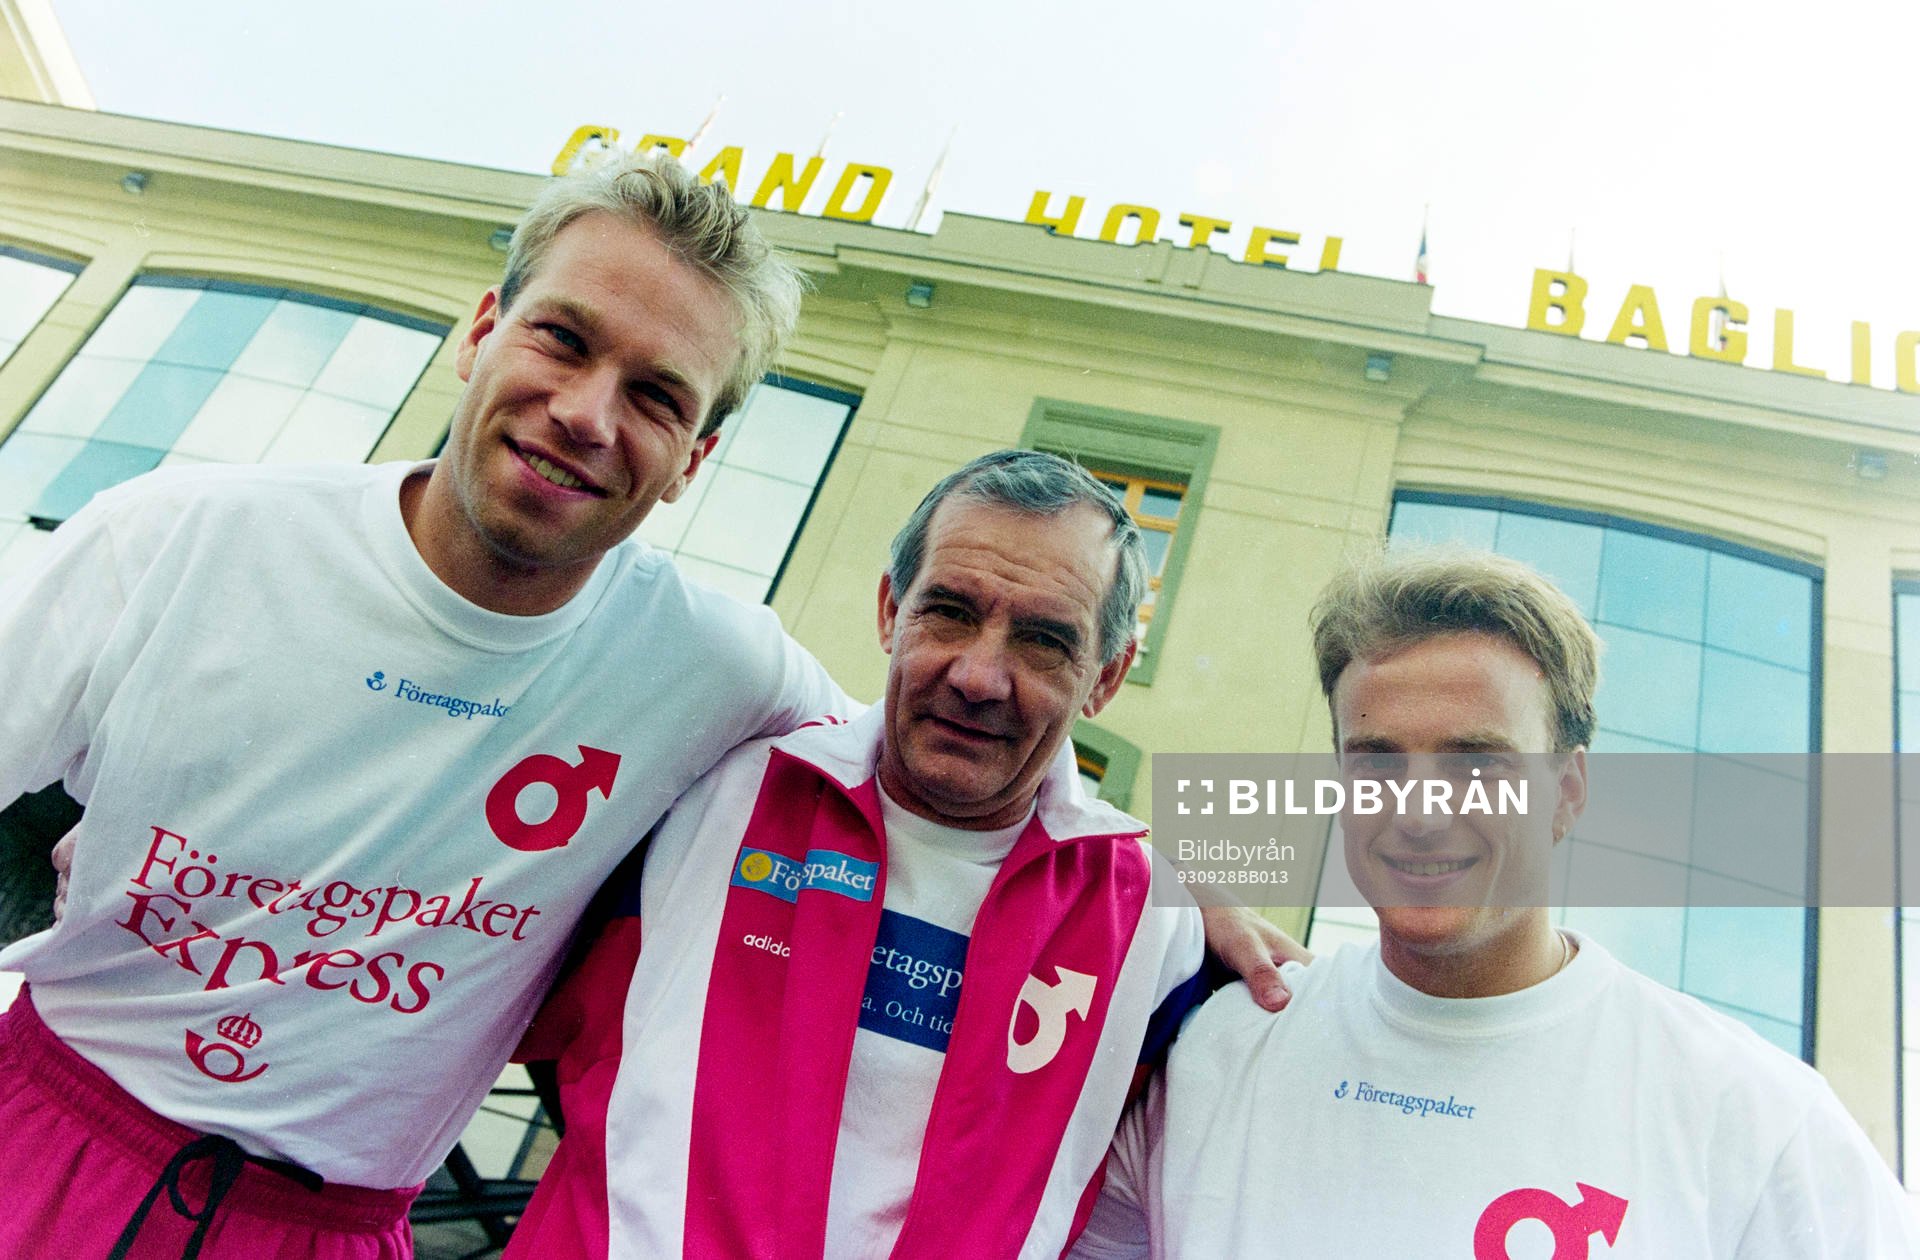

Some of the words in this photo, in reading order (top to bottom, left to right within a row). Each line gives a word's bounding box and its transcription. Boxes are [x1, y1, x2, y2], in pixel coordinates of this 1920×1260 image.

[130, 825, 541, 941] Företagspaket
[115, 890, 444, 1014] Express
[885, 1000, 924, 1026] Och
[1354, 1081, 1476, 1119] Företagspaket
